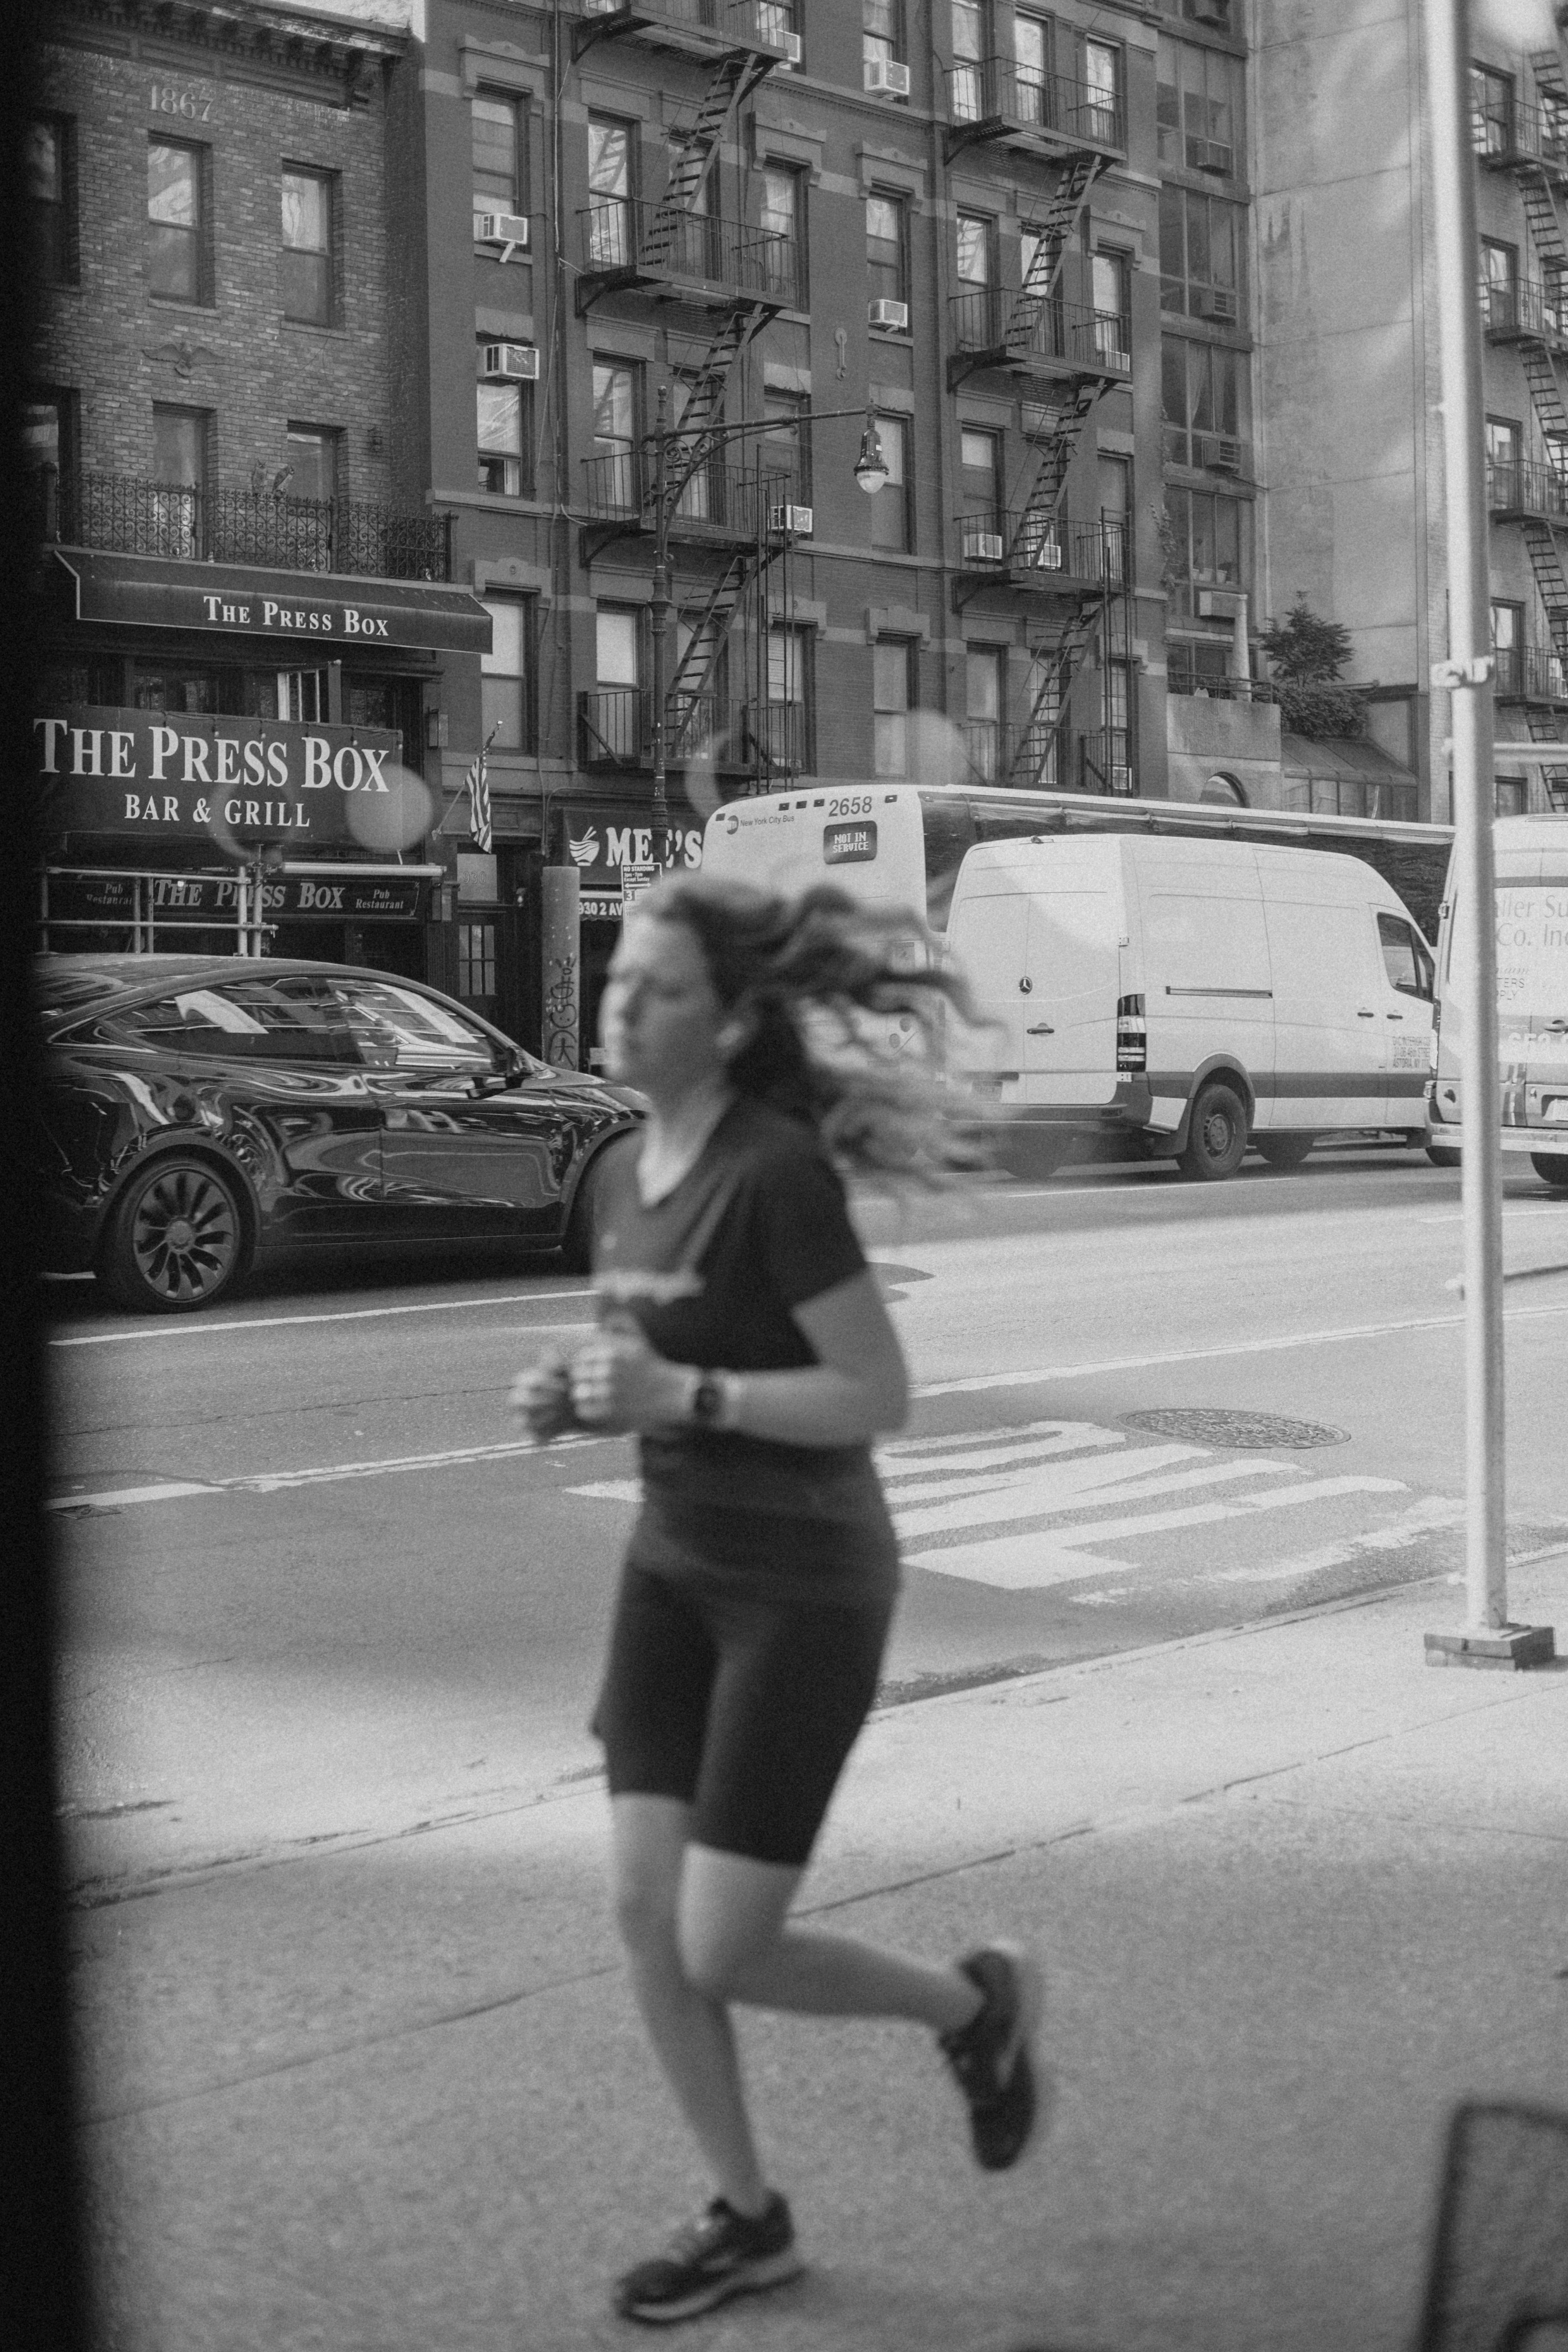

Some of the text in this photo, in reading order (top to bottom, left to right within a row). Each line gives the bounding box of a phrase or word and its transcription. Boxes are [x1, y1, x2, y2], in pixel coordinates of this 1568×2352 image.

[149, 85, 214, 122] 1867
[204, 596, 389, 636] THE PRESS BOX
[34, 718, 390, 793] THE PRESS BOX
[125, 794, 310, 827] BAR & GRILL
[829, 796, 872, 817] 2658
[769, 816, 781, 824] City
[834, 831, 867, 844] NOT IN
[833, 841, 869, 853] SERVICE
[463, 870, 486, 885] 930
[105, 883, 123, 894] Pub
[153, 879, 203, 906] THE
[297, 882, 346, 909] BOX
[373, 889, 390, 899] Pub
[626, 891, 633, 900] 3
[355, 898, 404, 909] Restaurant
[578, 902, 598, 916] 930
[599, 902, 607, 916] 2
[1496, 922, 1531, 946] Co.
